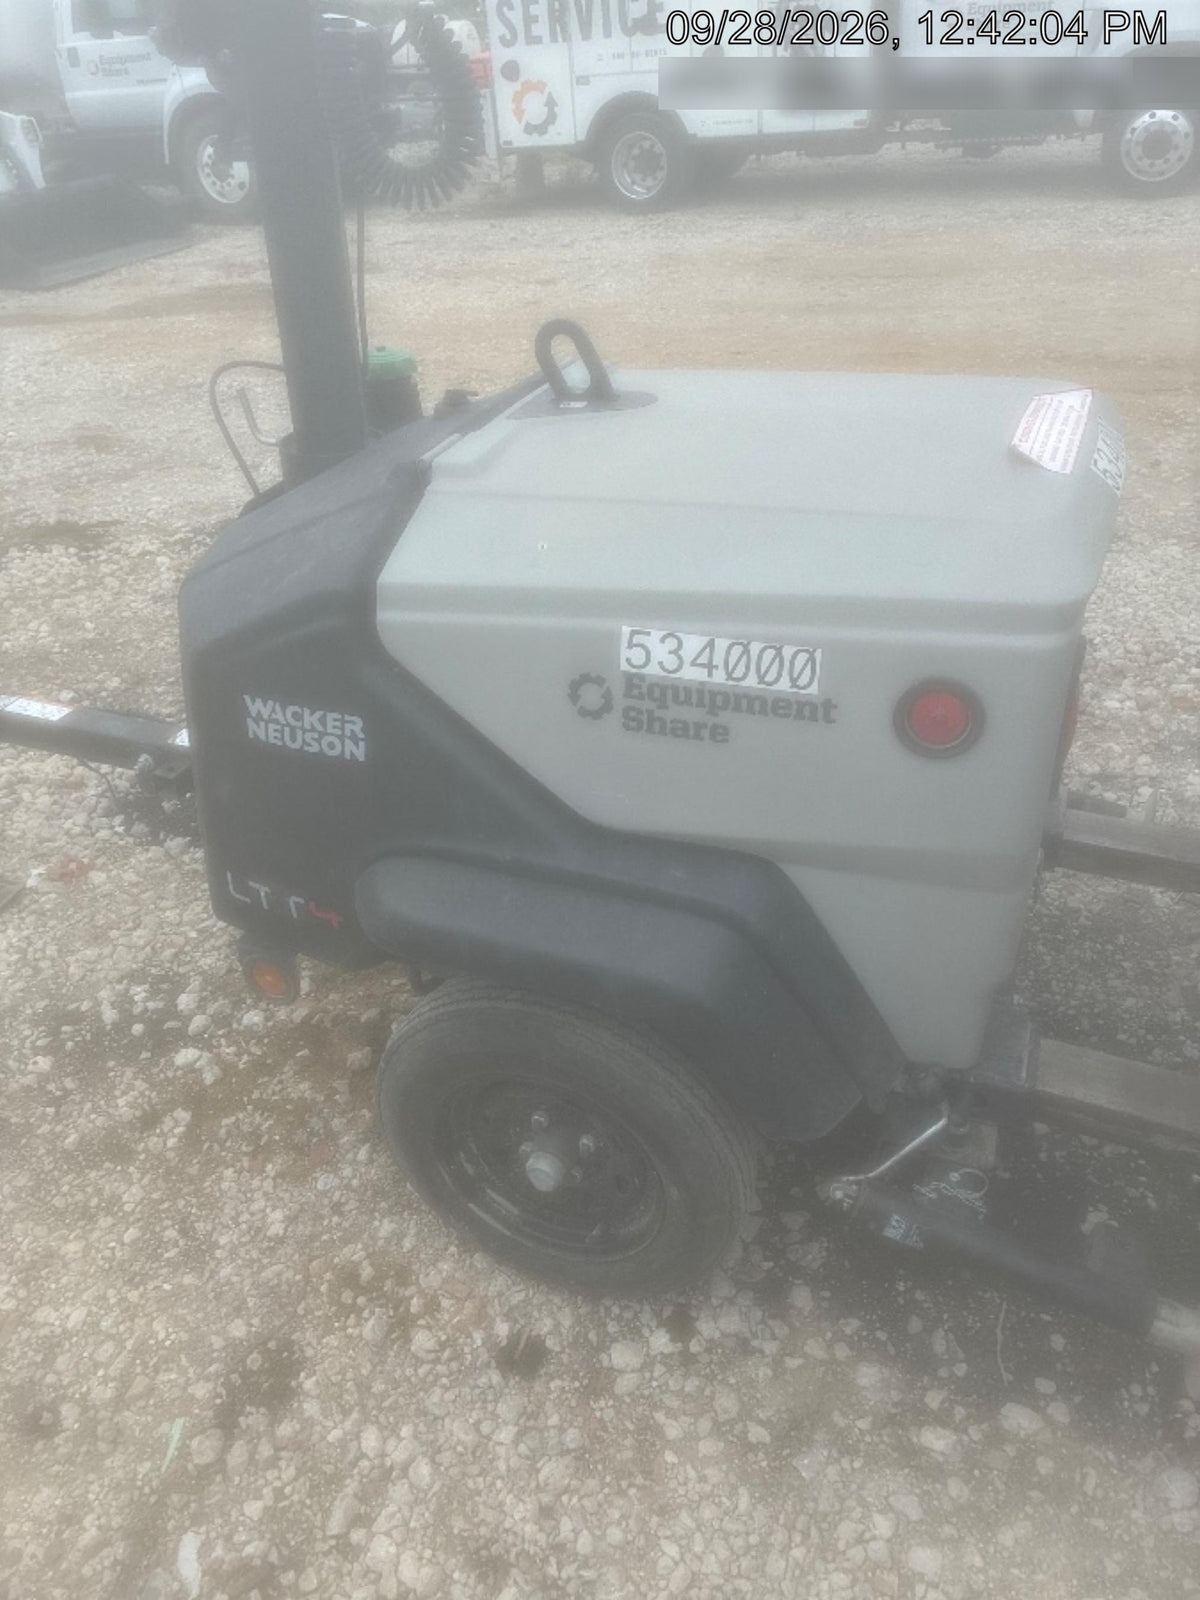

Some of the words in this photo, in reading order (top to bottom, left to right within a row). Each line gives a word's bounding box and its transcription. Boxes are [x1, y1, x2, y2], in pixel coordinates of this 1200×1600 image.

[496, 0, 668, 48] SERVICE
[624, 628, 817, 690] 534000
[243, 693, 366, 738] WACKER
[621, 670, 839, 724] Equipment
[246, 717, 366, 762] NEUSON
[621, 703, 731, 743] Share
